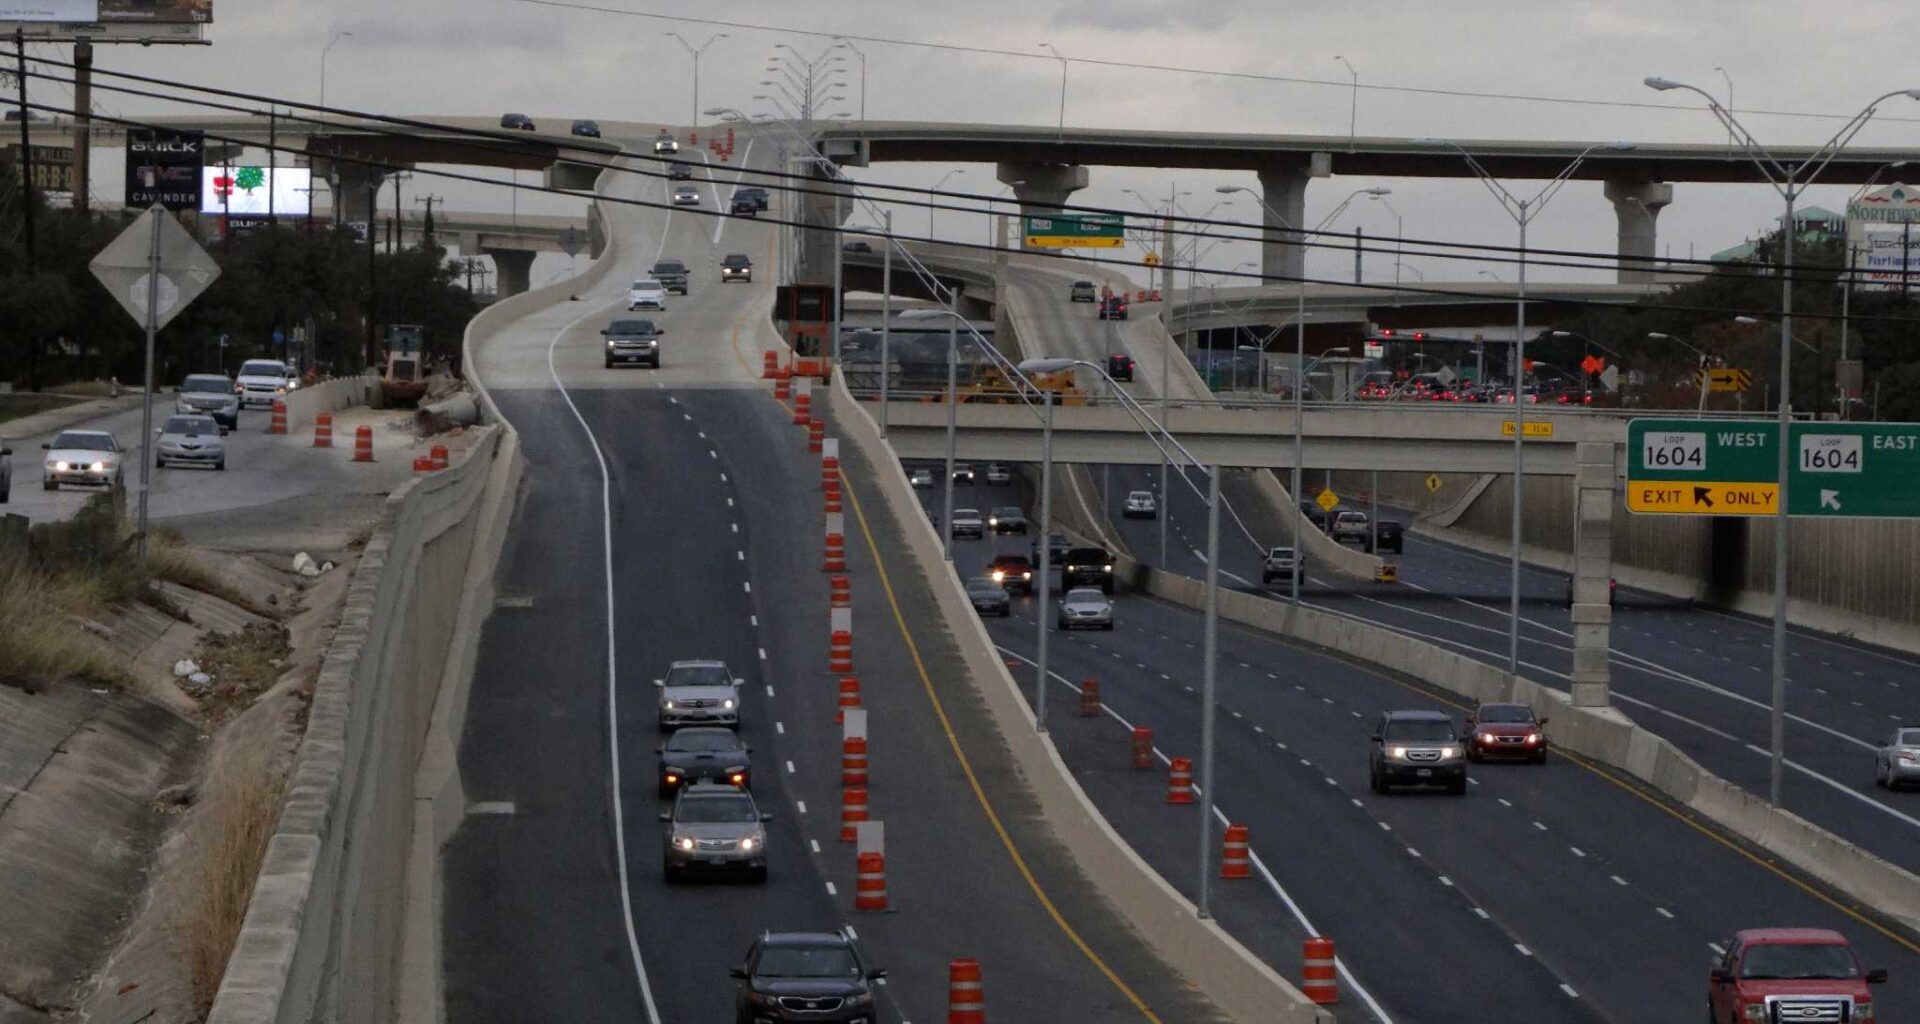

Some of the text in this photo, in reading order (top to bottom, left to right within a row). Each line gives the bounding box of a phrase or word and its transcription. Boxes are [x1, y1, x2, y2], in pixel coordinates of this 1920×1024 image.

[132, 192, 196, 203] CAVNDER
[1664, 435, 1685, 444] LOOP
[1717, 432, 1767, 447] WEST
[1873, 435, 1917, 449] EAST
[1647, 446, 1702, 466] 1604
[1803, 448, 1858, 469] 1604
[1643, 489, 1682, 504] EXIT
[1725, 491, 1774, 505] ONLY
